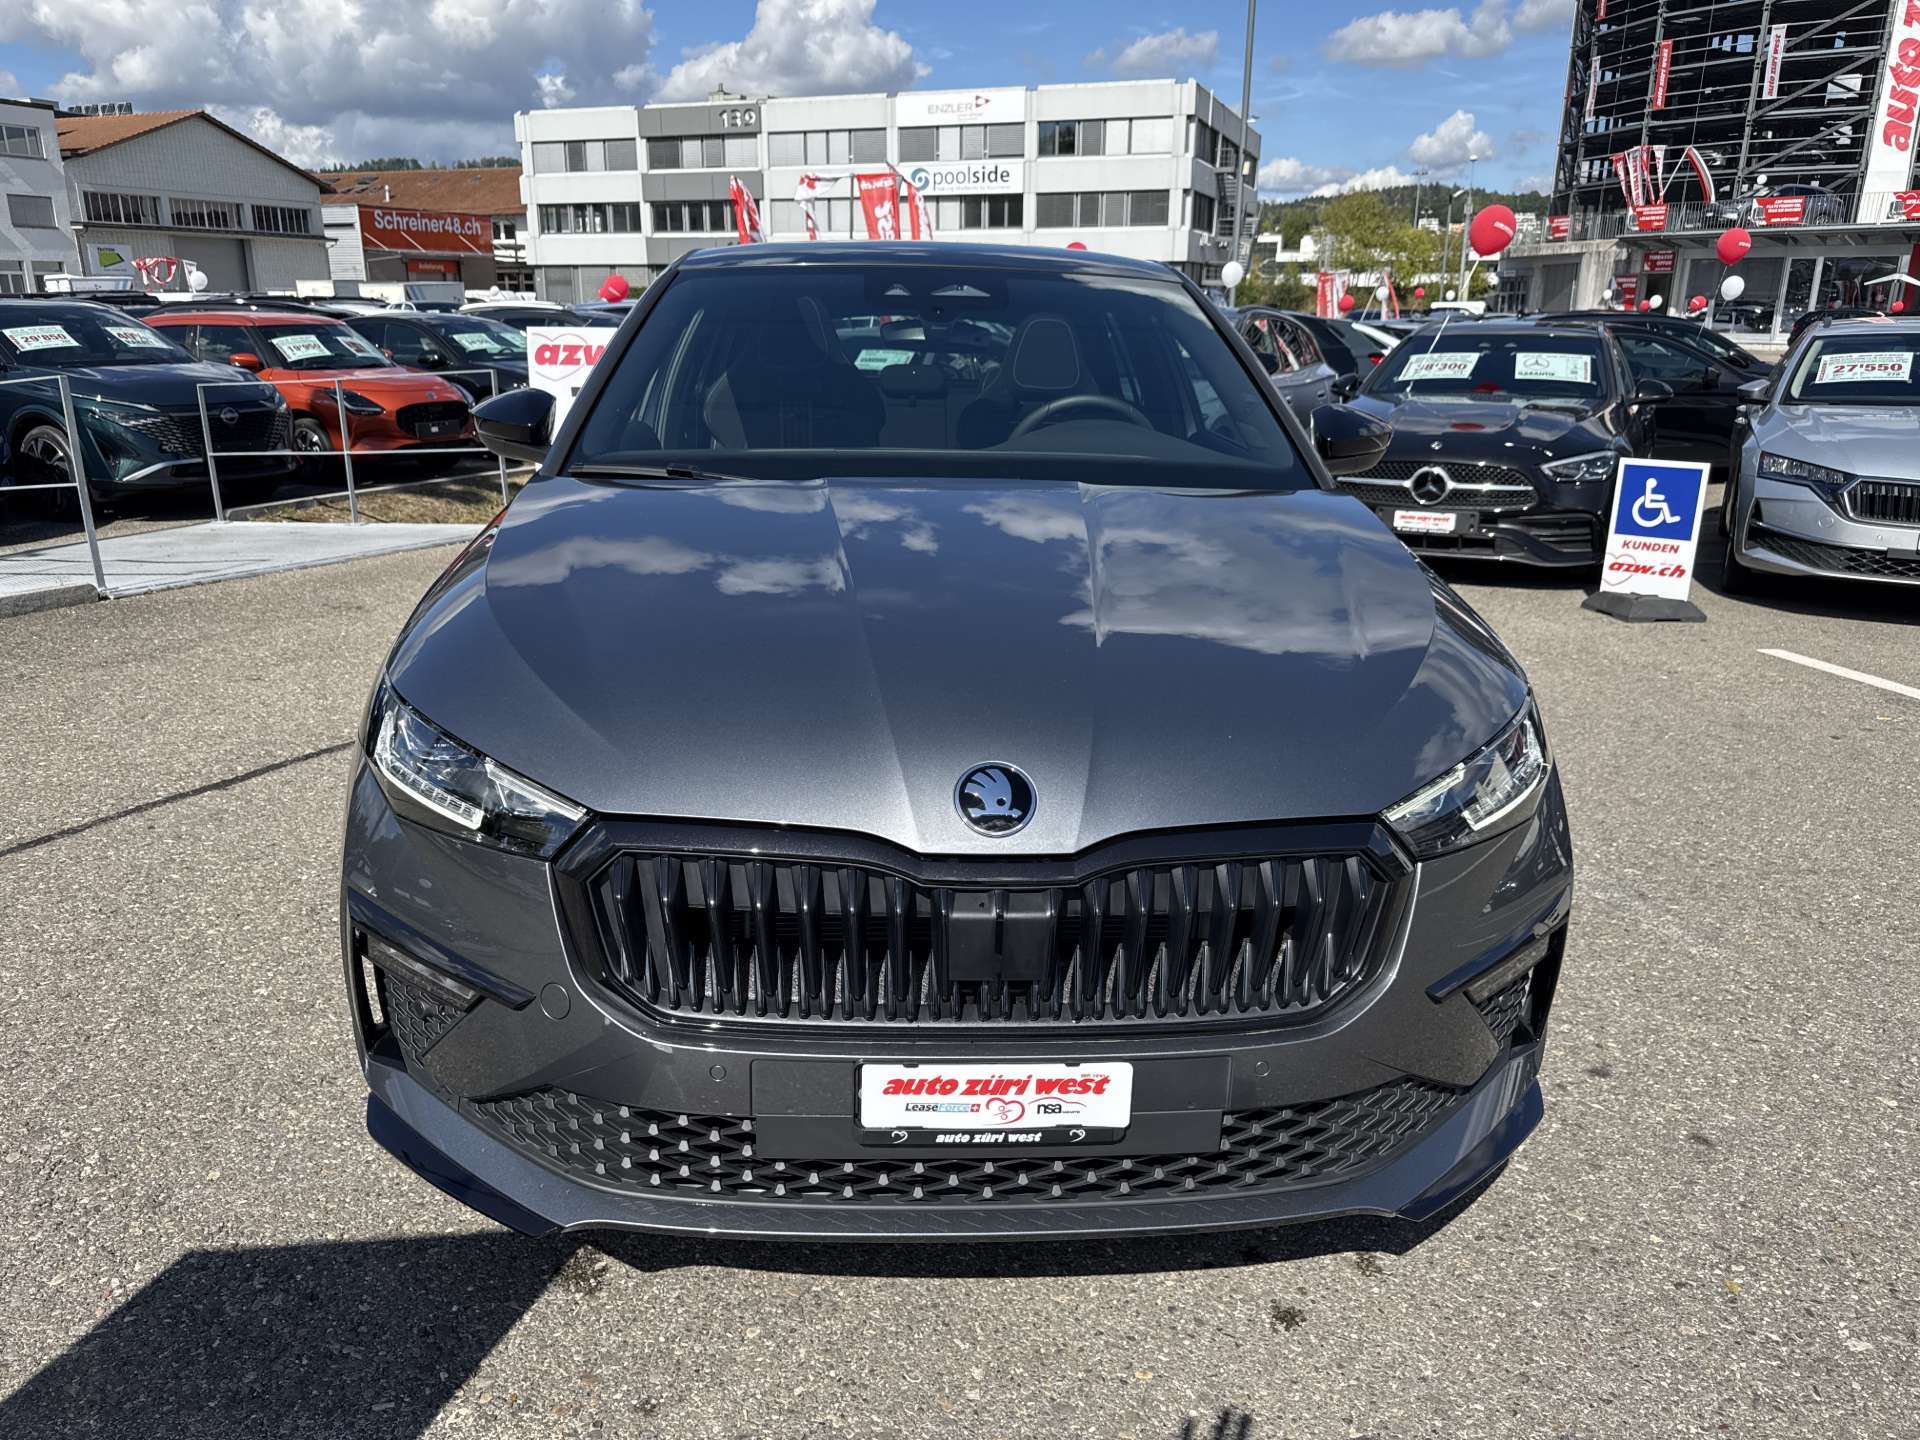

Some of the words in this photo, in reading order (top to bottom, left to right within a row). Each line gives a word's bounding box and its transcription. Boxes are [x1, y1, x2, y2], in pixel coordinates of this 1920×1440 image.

[927, 103, 973, 114] ENZLER
[719, 108, 756, 128] 139
[933, 164, 1010, 191] poolside
[374, 209, 481, 235] Schreiner48.ch
[1833, 363, 1903, 373] 27'550
[1622, 540, 1680, 554] KUNDEN
[1608, 562, 1686, 578] azw.ch
[882, 1075, 959, 1095] auto
[960, 1074, 1032, 1095] züri
[1035, 1075, 1111, 1095] west
[905, 1103, 970, 1112] LeaseForce
[1037, 1103, 1062, 1114] nsa
[936, 1133, 970, 1143] auto
[972, 1132, 1006, 1143] züri
[1008, 1132, 1042, 1143] west
